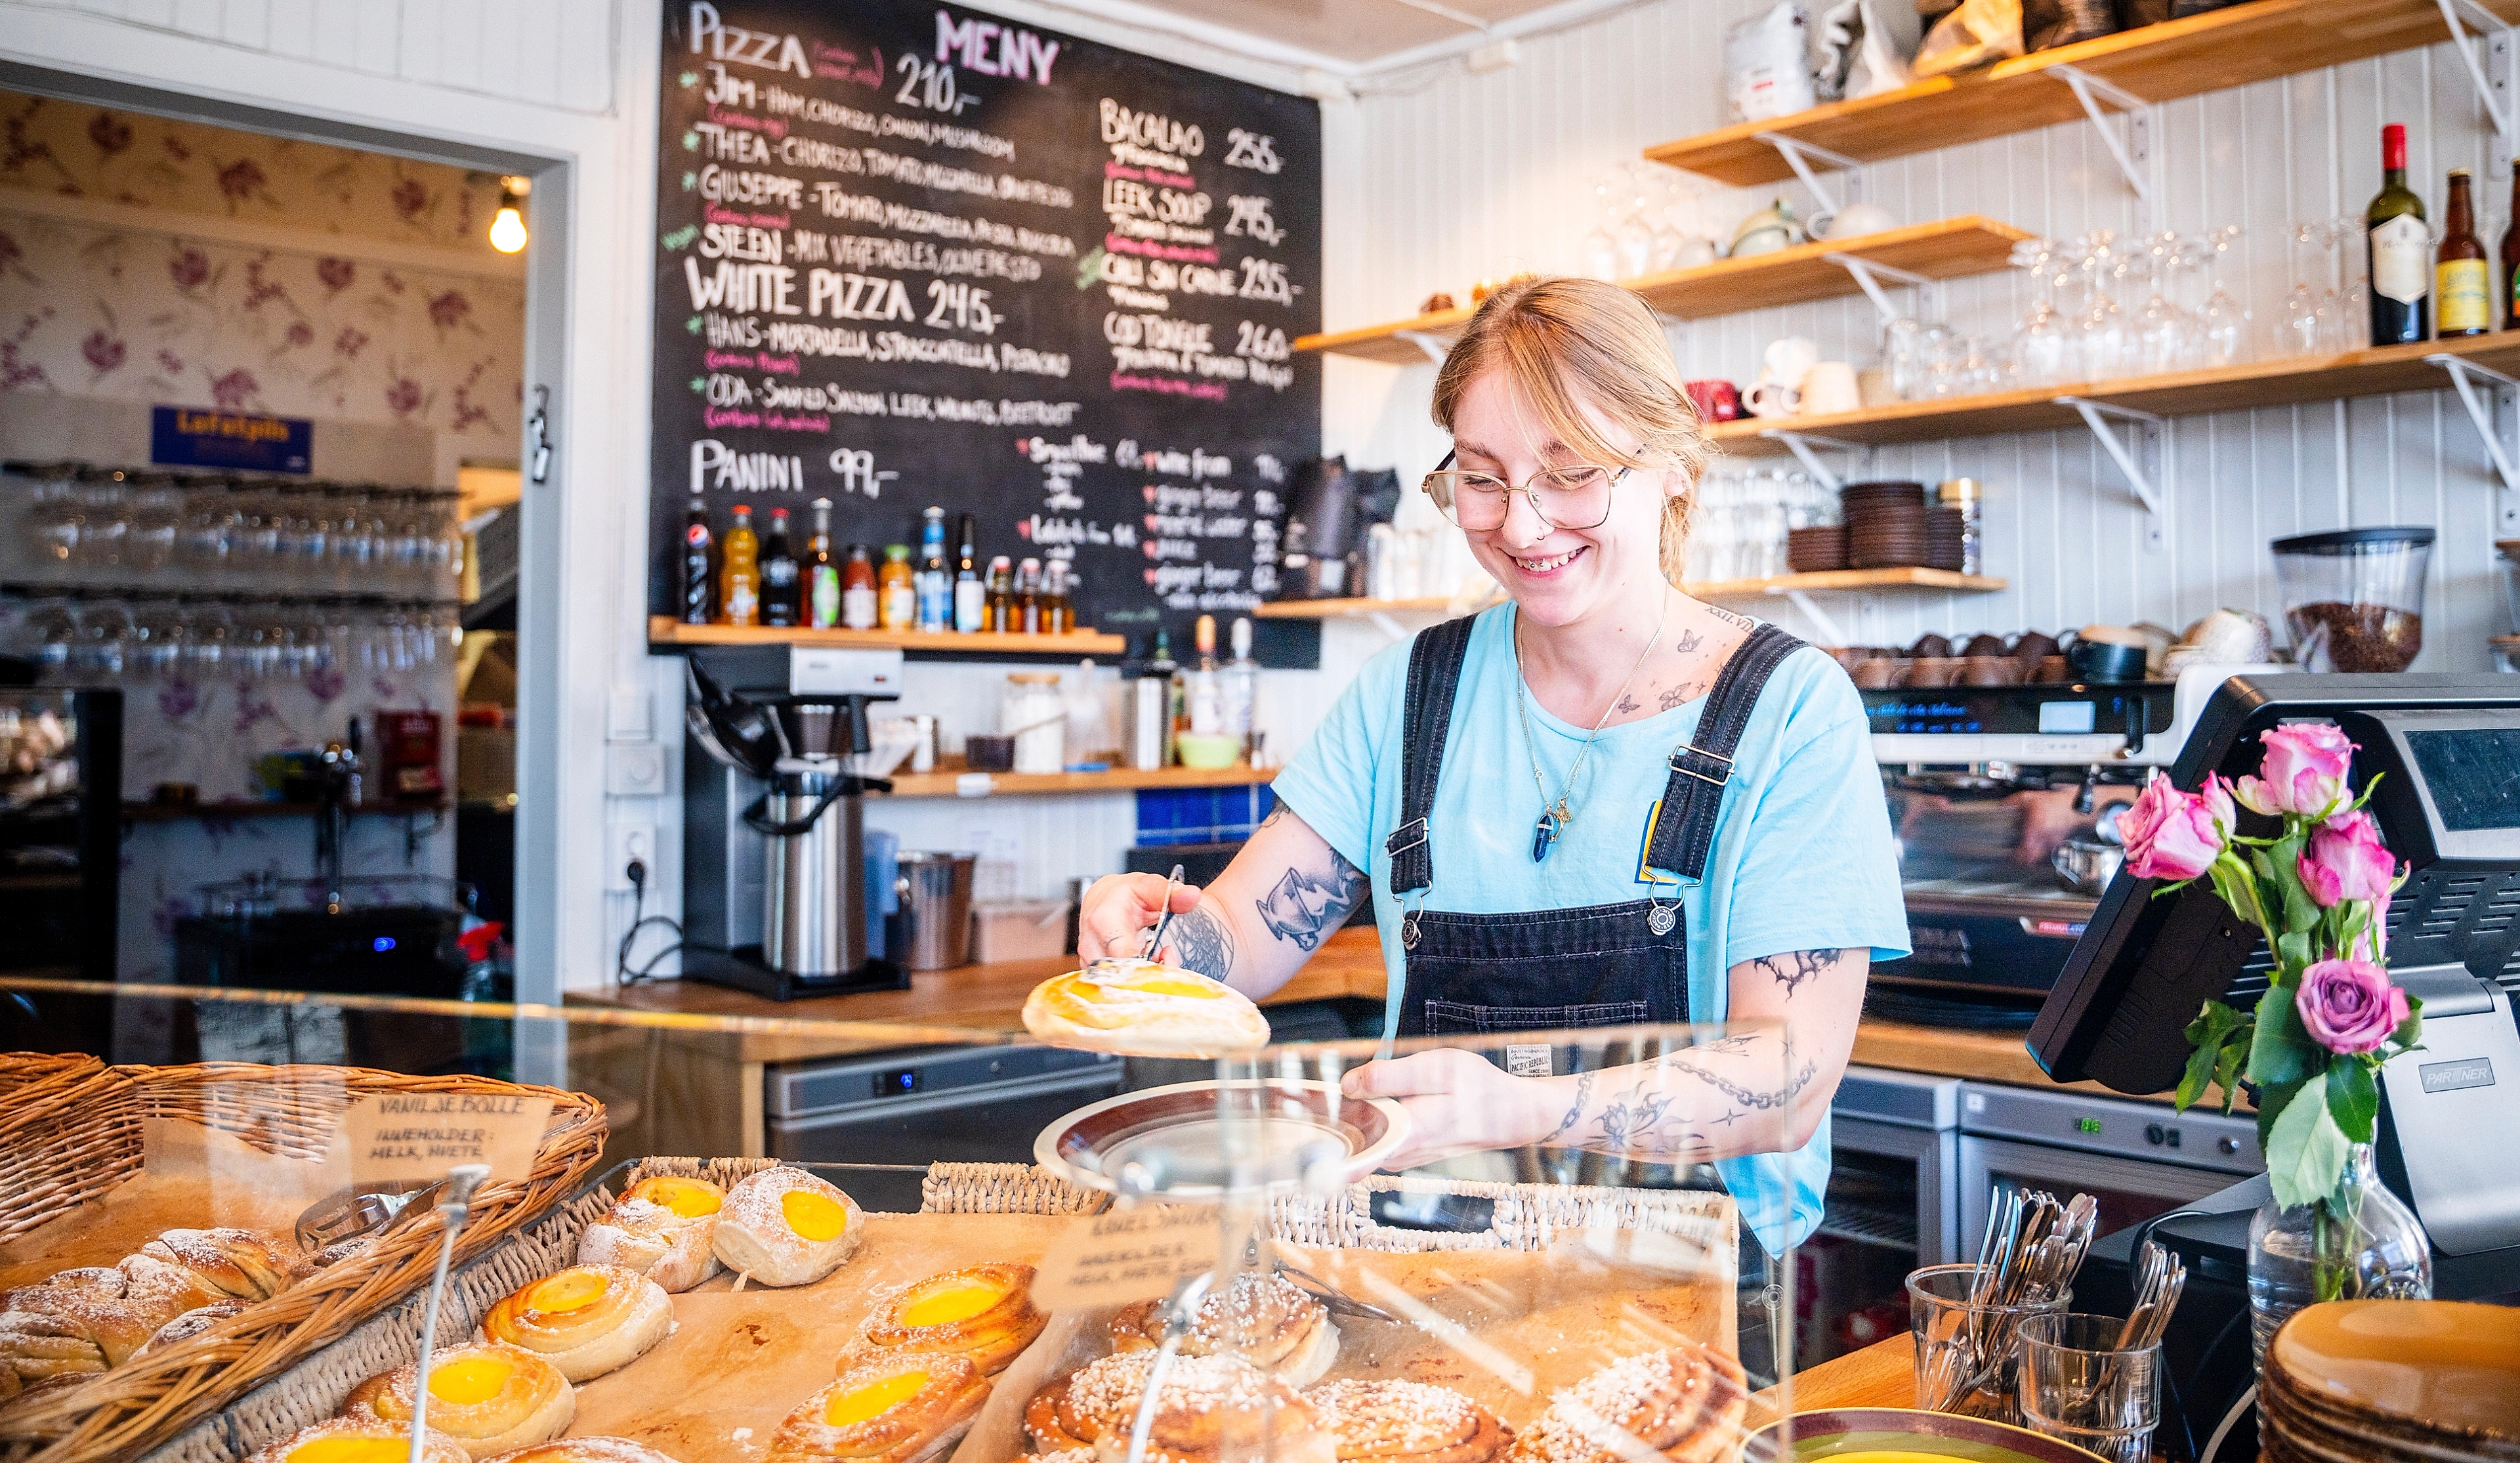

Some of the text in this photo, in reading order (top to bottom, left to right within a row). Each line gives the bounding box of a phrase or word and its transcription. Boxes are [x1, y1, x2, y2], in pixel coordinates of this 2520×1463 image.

[690, 1, 811, 79] PIZZA
[894, 53, 982, 116] 210,-
[935, 9, 1060, 85] MENY
[704, 62, 755, 108] JIM
[694, 121, 770, 165] THEA
[1100, 97, 1205, 158] BACALAO
[698, 163, 804, 210] GIUSEPPE
[1102, 177, 1157, 220] LEEK
[1157, 188, 1213, 225] SOUP
[698, 222, 782, 264] STEEN
[684, 255, 803, 315] WHITE
[808, 267, 915, 322] PIZZA
[704, 310, 761, 349] HANS
[706, 373, 753, 407] ODA
[690, 439, 803, 493] PANINI
[1511, 1055, 1548, 1072] PACIFIC REPUBLIC
[2426, 1065, 2488, 1085] PARTNER
